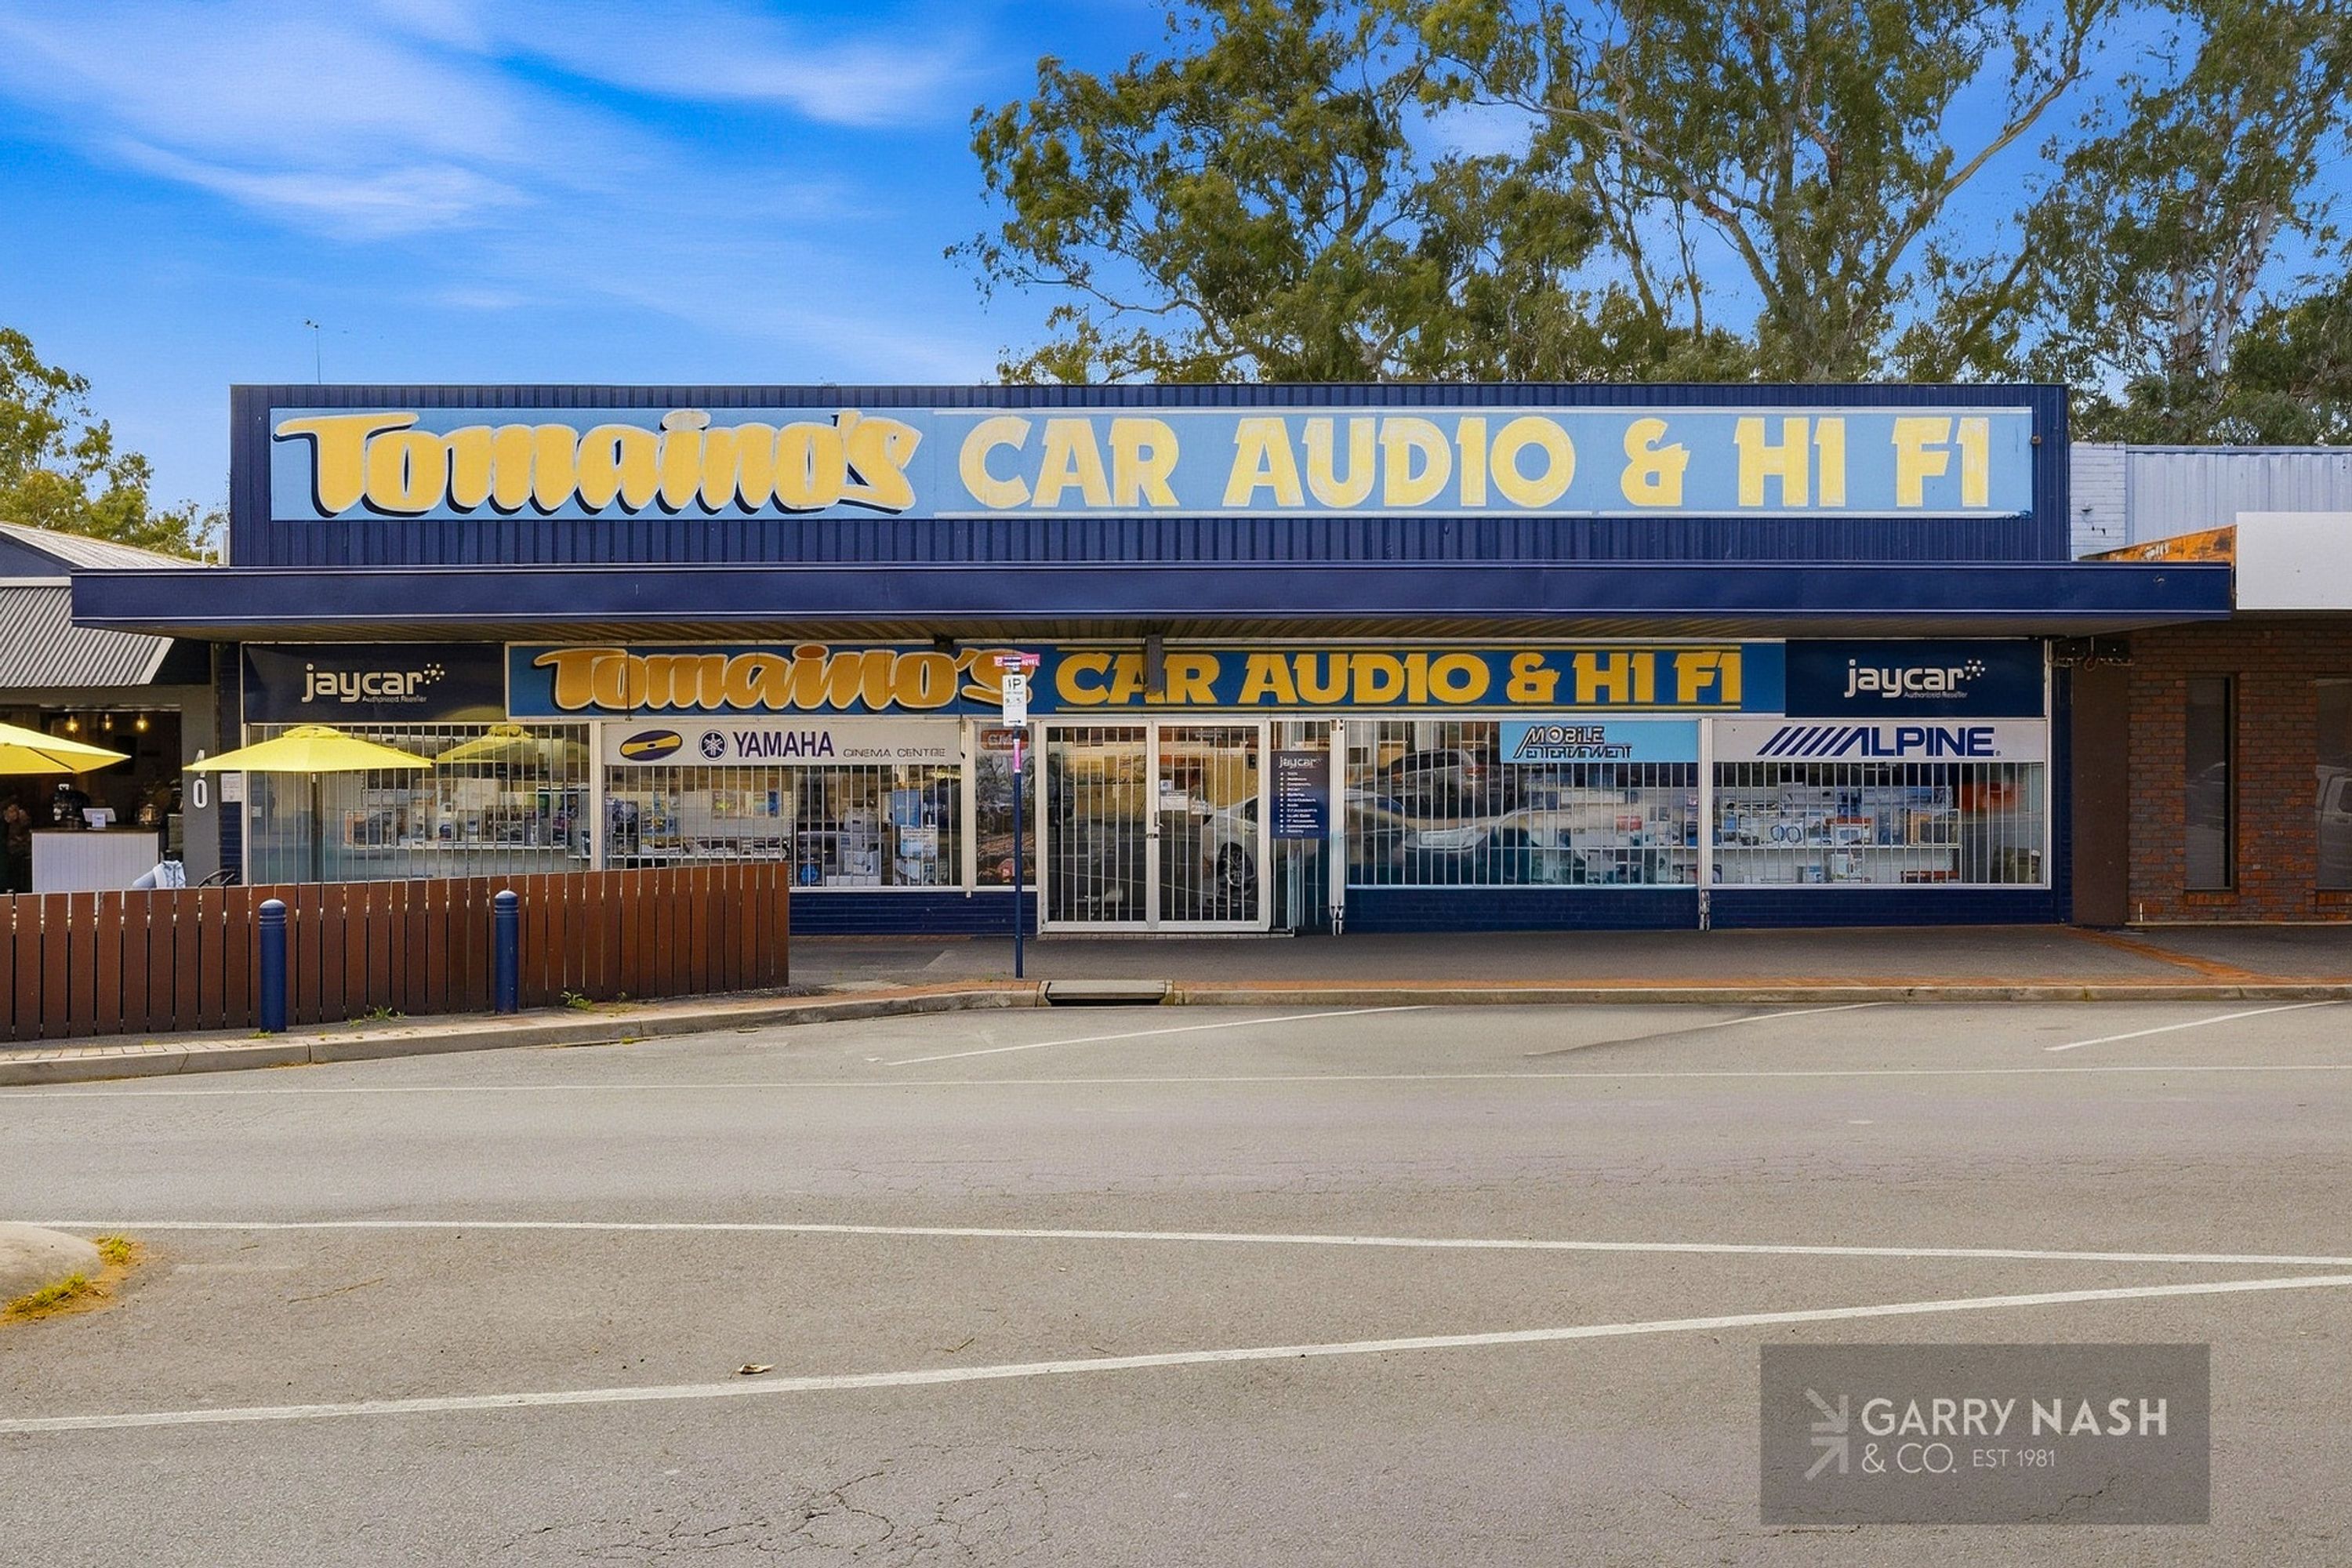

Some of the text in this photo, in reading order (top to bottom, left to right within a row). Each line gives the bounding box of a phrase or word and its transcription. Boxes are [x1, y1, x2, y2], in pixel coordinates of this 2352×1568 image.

[274, 410, 1990, 515] Tomaino's CAR AUDIO & HI FI
[301, 662, 423, 703] jaycar
[533, 643, 1741, 710] Tomaino's CAR AUDIO & HI FI
[1844, 659, 1965, 699] jaycar
[732, 731, 947, 758] YAMAHA CINEMA CENTRE
[1830, 726, 1996, 757] ALPINE
[1279, 756, 1318, 768] jaycar
